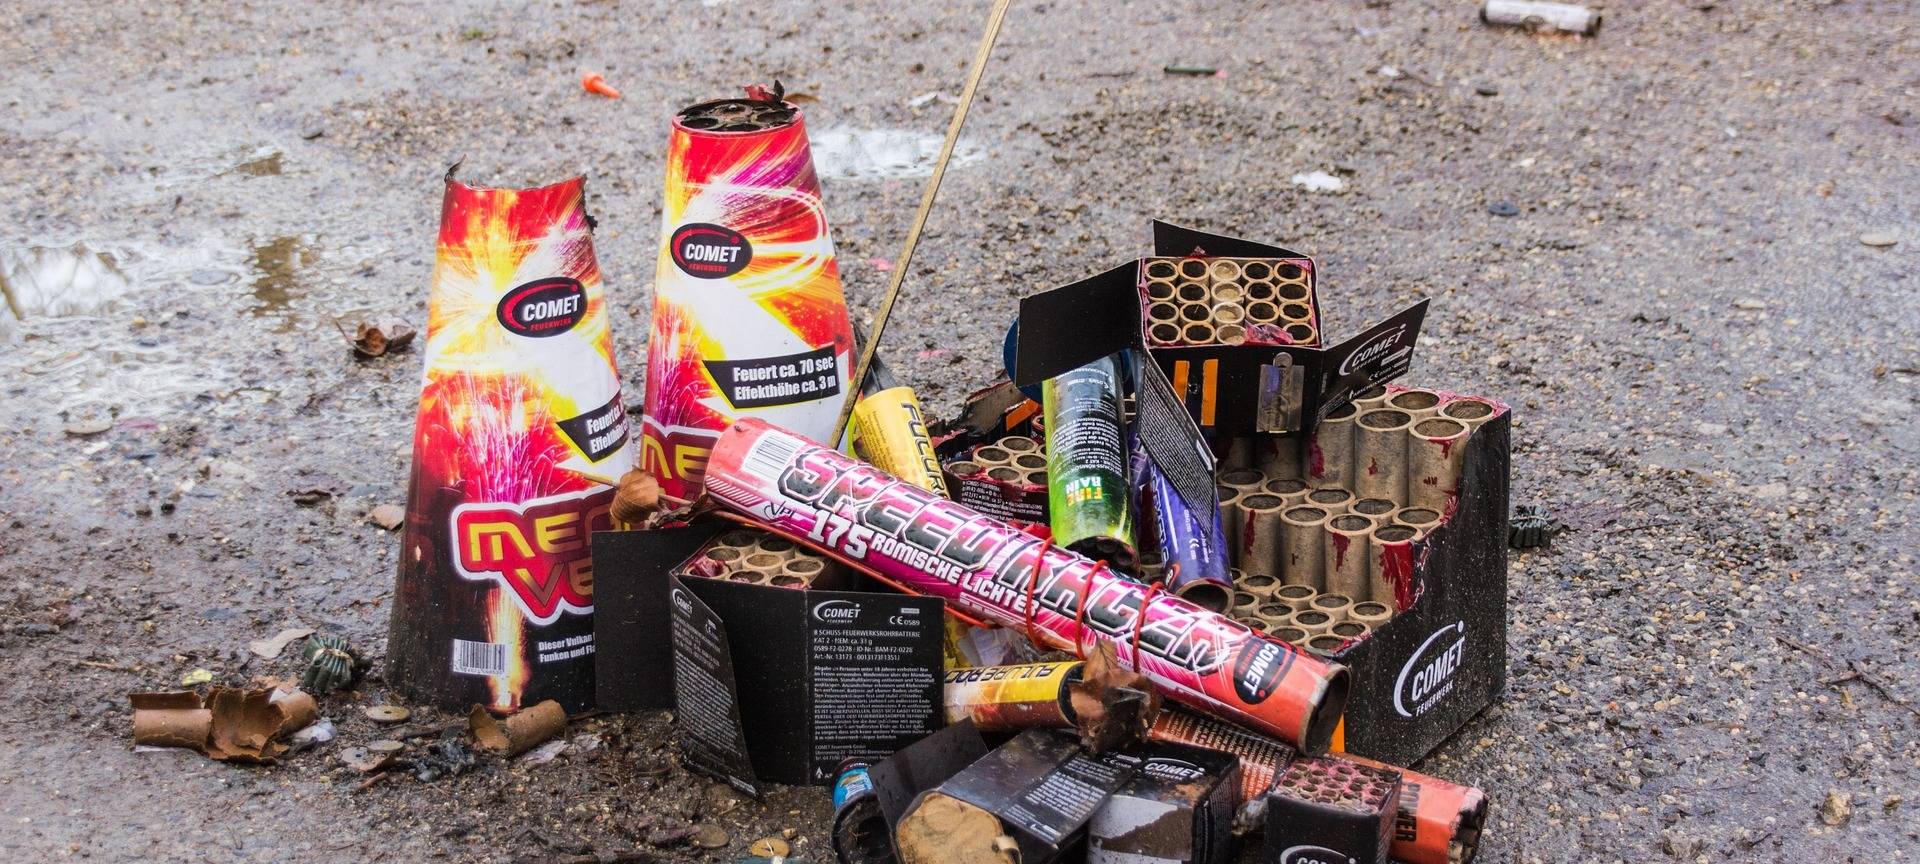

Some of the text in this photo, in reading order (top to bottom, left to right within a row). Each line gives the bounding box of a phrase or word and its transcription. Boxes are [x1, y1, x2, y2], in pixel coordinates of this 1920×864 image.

[686, 243, 741, 263] COMET
[522, 294, 580, 322] COMET
[1352, 329, 1406, 368] COMET
[733, 356, 834, 382] Feuert ca. 70 sec
[734, 375, 836, 400] Effekthöhe ca. 3 m
[586, 408, 615, 435] Feuert
[642, 434, 711, 483] ME
[1066, 476, 1102, 494] RAIN
[1066, 487, 1103, 507] FIRE
[469, 502, 611, 562] ME
[777, 447, 1009, 571] SPEED
[998, 533, 1252, 675] RACER
[808, 510, 875, 559] 175
[962, 571, 1041, 617] LICHTER
[514, 556, 593, 607] VE
[824, 608, 861, 618] COMET
[538, 634, 592, 651] Dieser Vulkan
[540, 651, 570, 663] Funken
[570, 648, 586, 658] und
[1242, 642, 1280, 696] COMET
[1412, 634, 1466, 702] COMET
[1144, 762, 1204, 780] COMET
